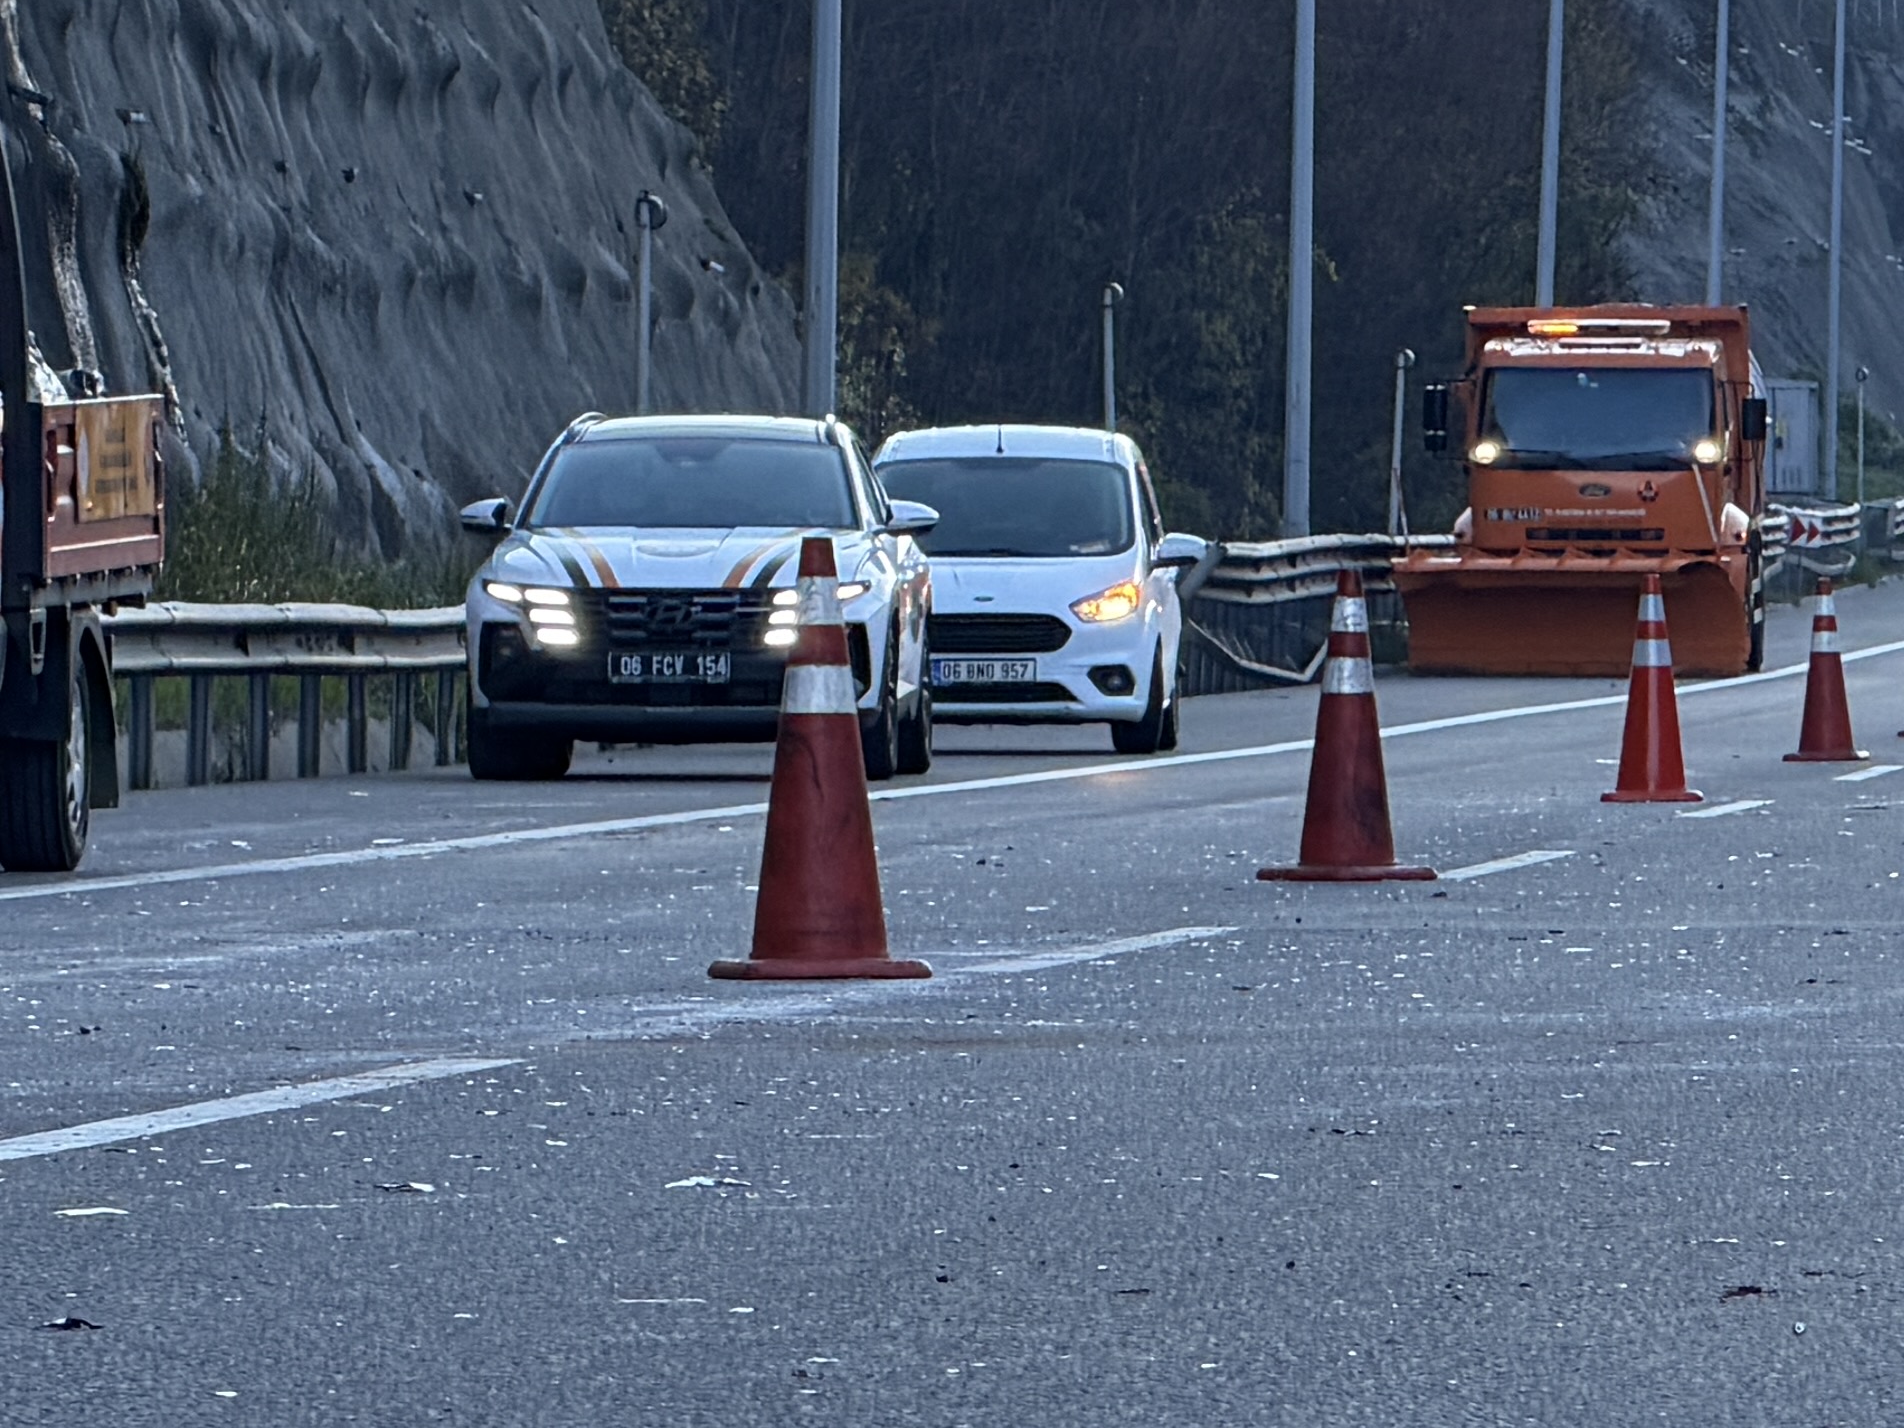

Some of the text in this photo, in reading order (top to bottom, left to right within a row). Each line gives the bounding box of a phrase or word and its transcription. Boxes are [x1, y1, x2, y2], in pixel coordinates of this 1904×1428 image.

[620, 654, 727, 676] 06 FCV 154
[943, 662, 962, 680] 06
